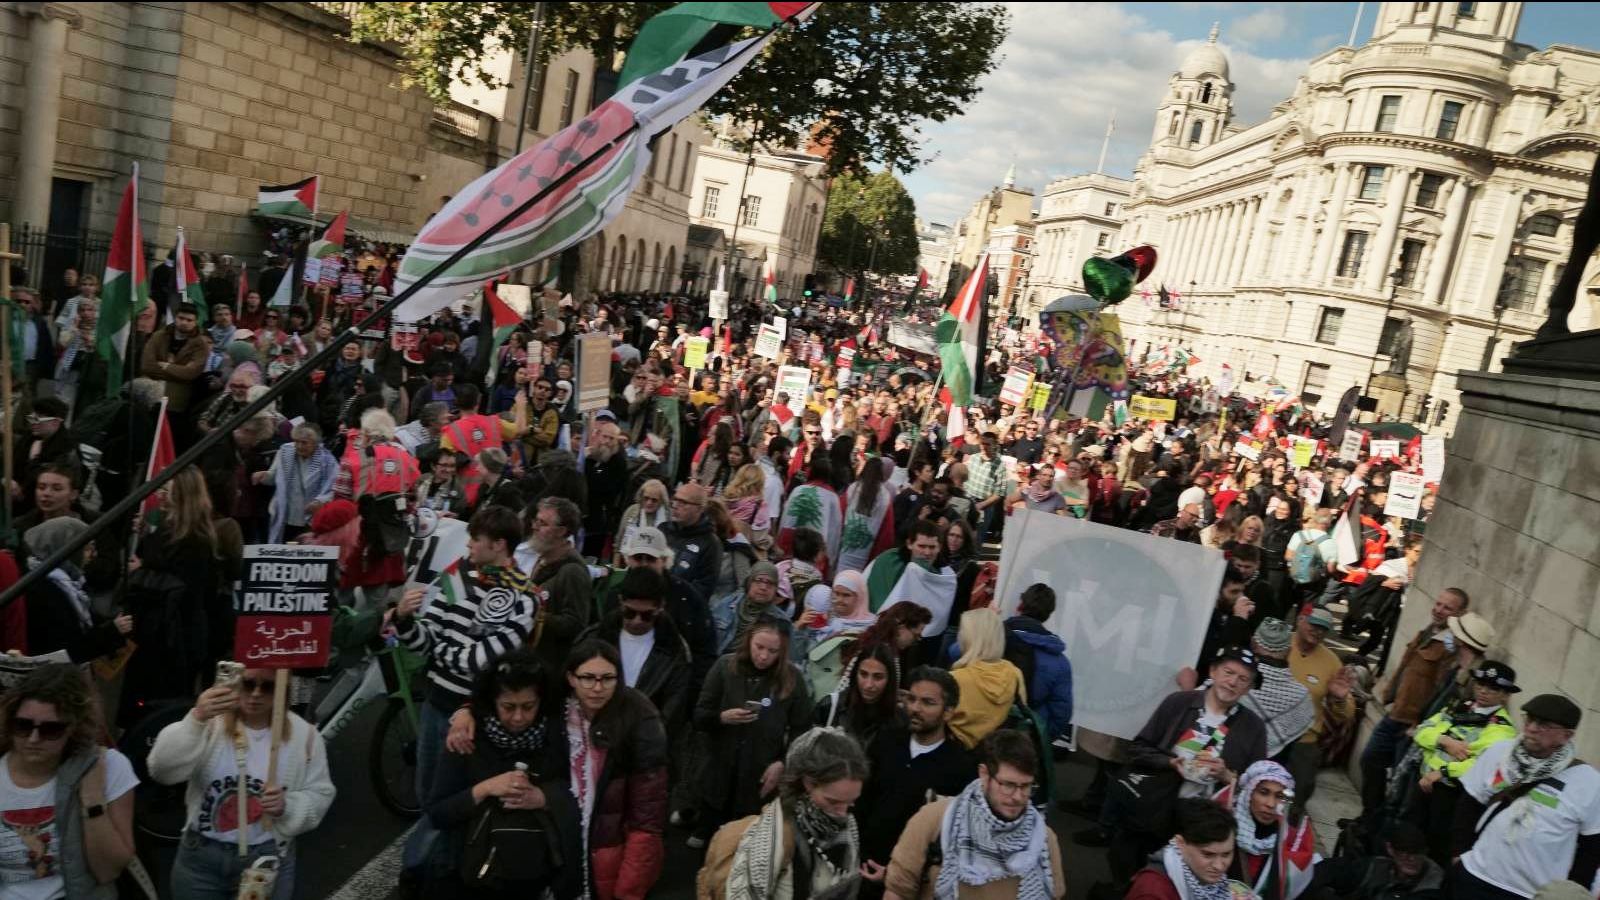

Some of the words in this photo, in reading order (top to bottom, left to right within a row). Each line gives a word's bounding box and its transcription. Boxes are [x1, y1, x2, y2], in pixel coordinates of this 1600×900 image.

[257, 547, 295, 558] Socialist
[296, 549, 326, 558] Worker
[249, 562, 329, 583] FREEDOM
[243, 592, 330, 613] PALESTINE
